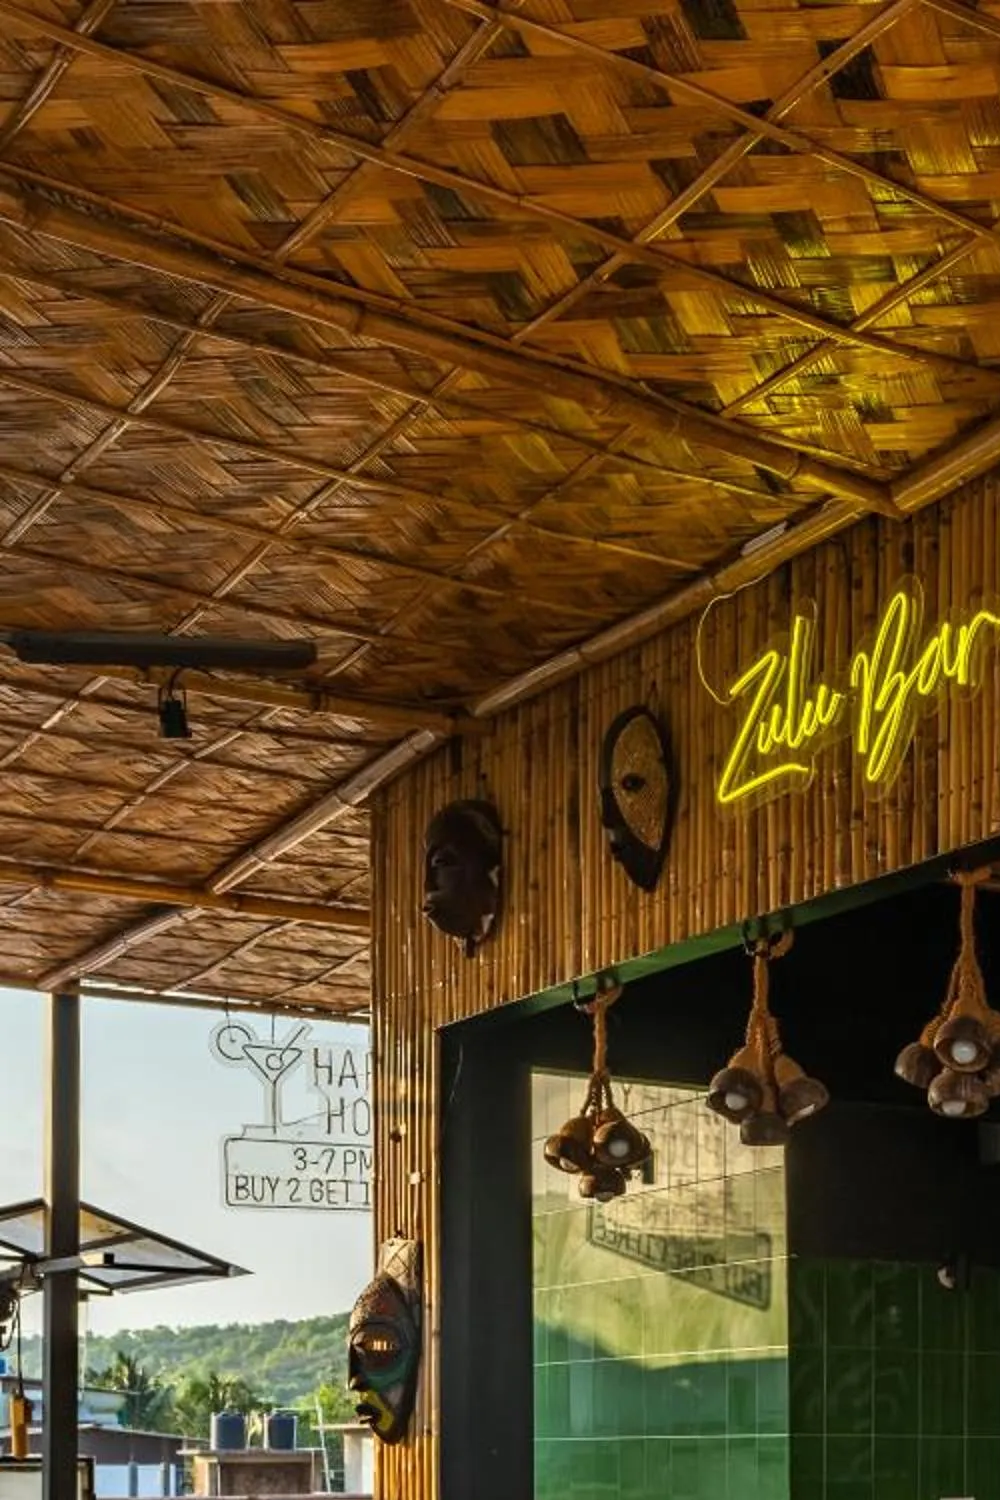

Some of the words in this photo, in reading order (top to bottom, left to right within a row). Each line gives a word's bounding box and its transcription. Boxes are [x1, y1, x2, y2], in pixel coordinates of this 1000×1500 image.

[718, 614, 842, 803] Zulu
[327, 1097, 371, 1136] HO
[293, 1147, 336, 1174] 3-7
[235, 1175, 280, 1203] BUY
[286, 1177, 303, 1203] 2
[310, 1178, 350, 1205] GET
